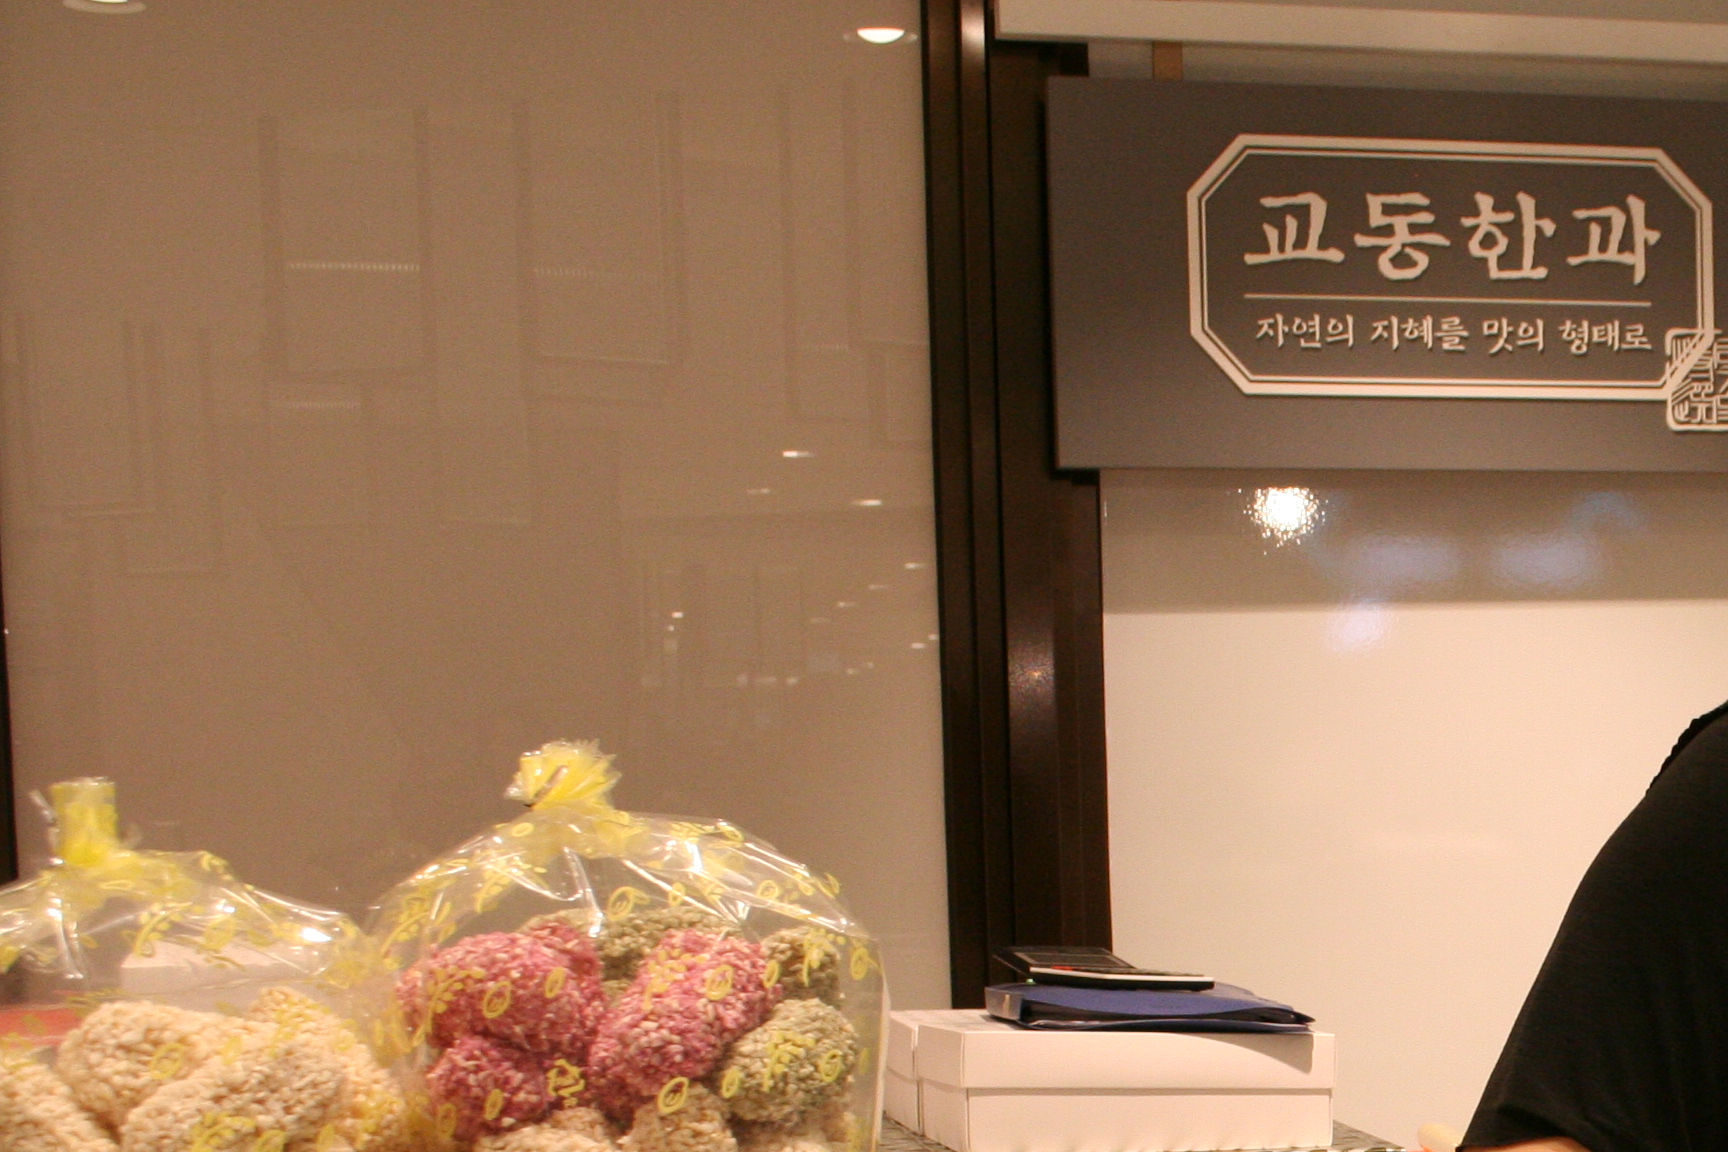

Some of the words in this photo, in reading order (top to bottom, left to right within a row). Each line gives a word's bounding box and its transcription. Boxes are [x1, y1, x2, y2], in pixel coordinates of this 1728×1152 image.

[1243, 191, 1662, 286] 교동한과
[1256, 313, 1355, 349] 자연의
[1370, 314, 1470, 351] 지혜를
[1481, 317, 1545, 354] 맛의
[1558, 319, 1652, 355] 형태로
